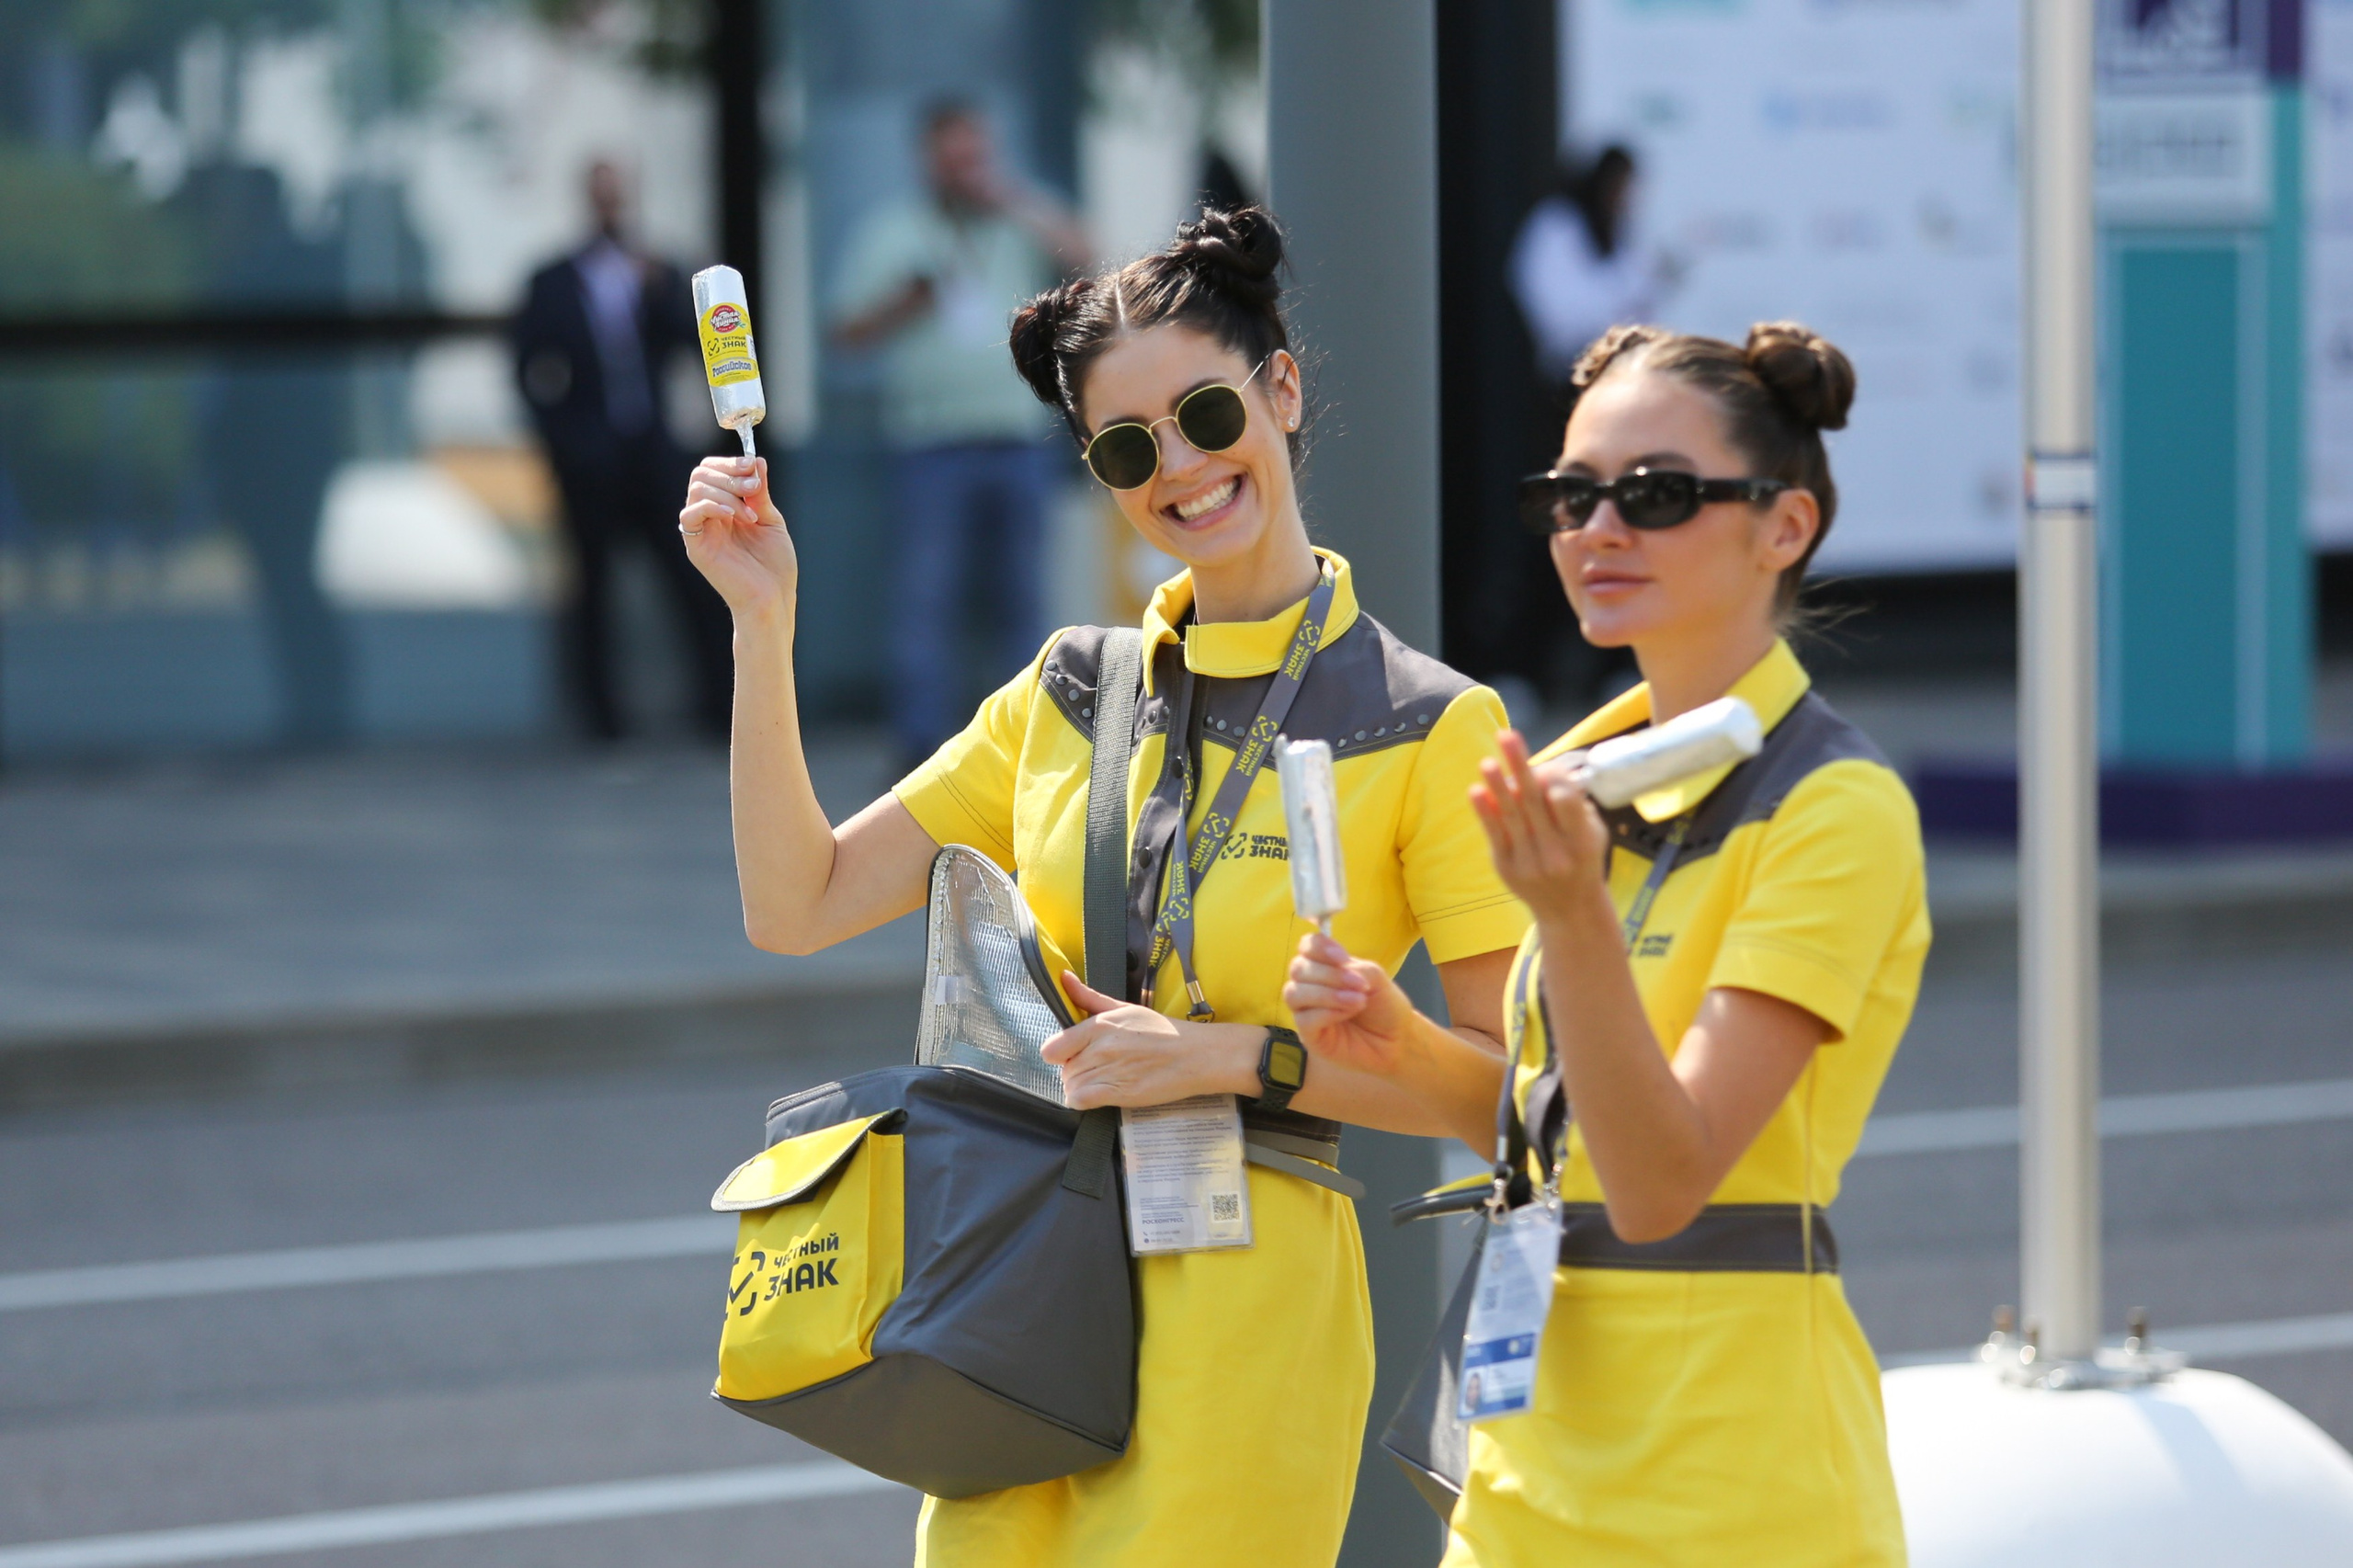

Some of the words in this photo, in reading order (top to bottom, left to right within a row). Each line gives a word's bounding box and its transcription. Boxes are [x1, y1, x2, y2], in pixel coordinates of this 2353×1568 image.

[722, 340, 746, 349] ЗНАК
[1283, 643, 1305, 677] ЗНАК
[1292, 648, 1311, 681] ЧЕСТНЫЙ
[1235, 739, 1258, 773] ЗНАК
[1245, 744, 1265, 777] ЧЕСТНЫЙ
[1188, 836, 1211, 870] ЗНАК
[1198, 840, 1217, 873] ЧЕСТНЫЙ
[1176, 860, 1185, 895] ЗНАК
[1148, 936, 1165, 968] ЗНАК
[1142, 1217, 1185, 1225] РОСКОНГРЕСС
[774, 1233, 839, 1268] ЧЕСТНЫЙ
[764, 1257, 839, 1301] ЗНАК
